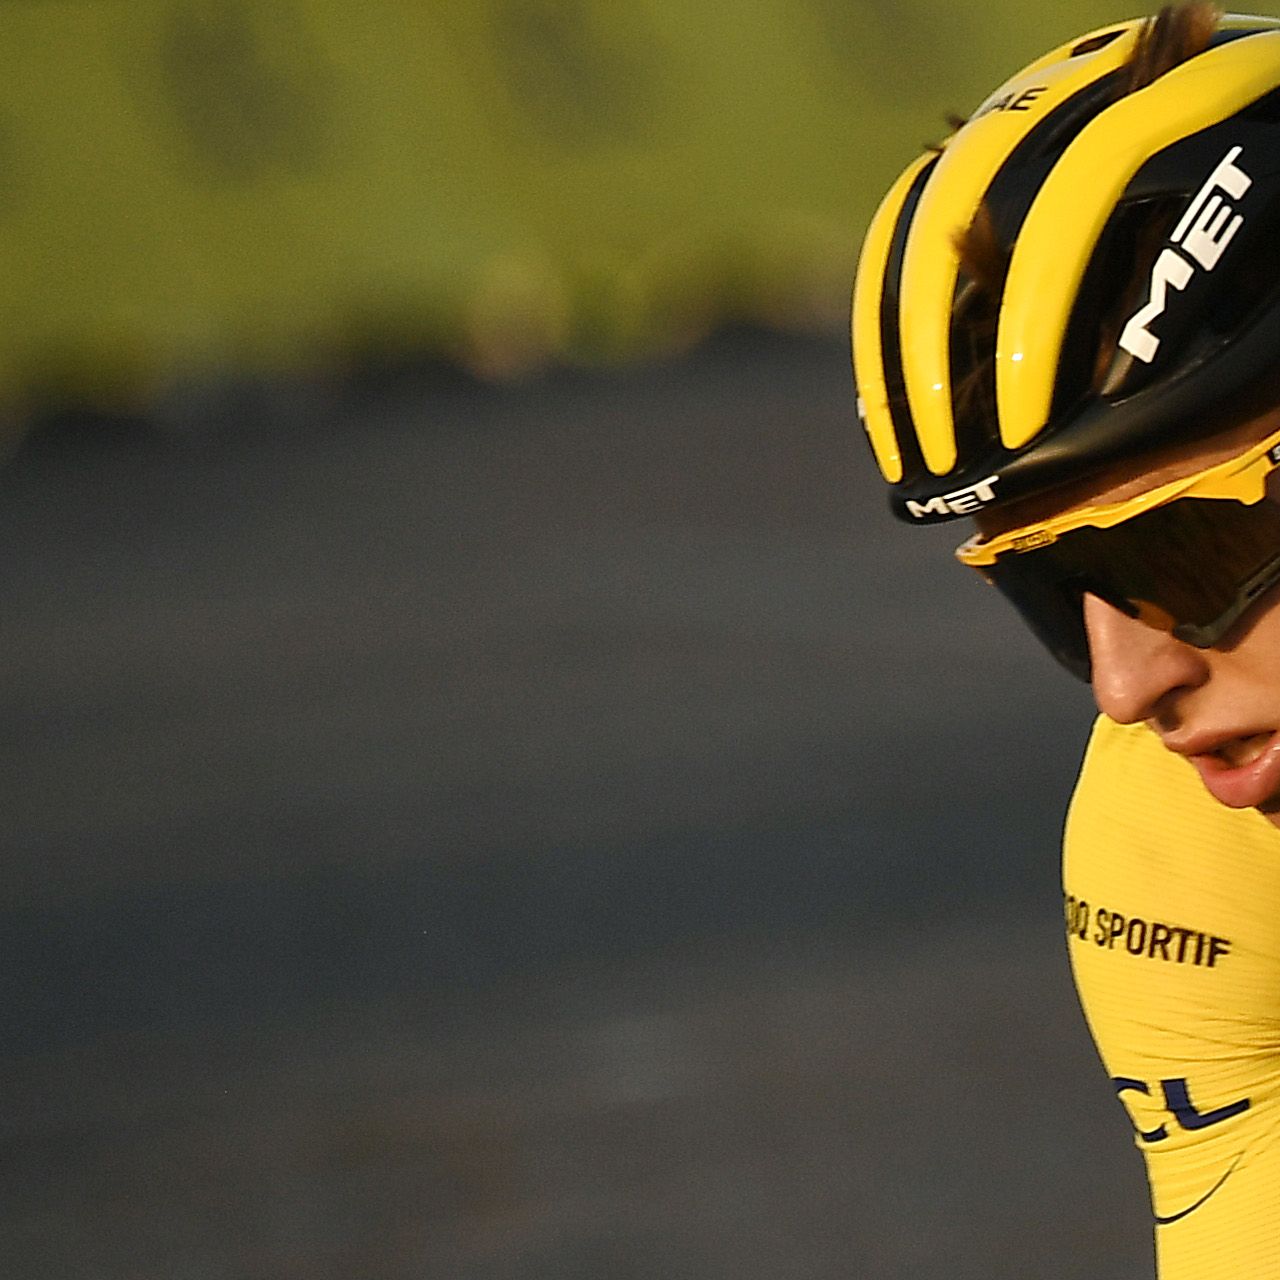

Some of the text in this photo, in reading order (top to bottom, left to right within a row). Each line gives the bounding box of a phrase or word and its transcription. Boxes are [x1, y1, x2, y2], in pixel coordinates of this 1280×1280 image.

[1118, 145, 1253, 364] MET
[904, 475, 1000, 519] MET
[1094, 907, 1234, 967] SPORTIF
